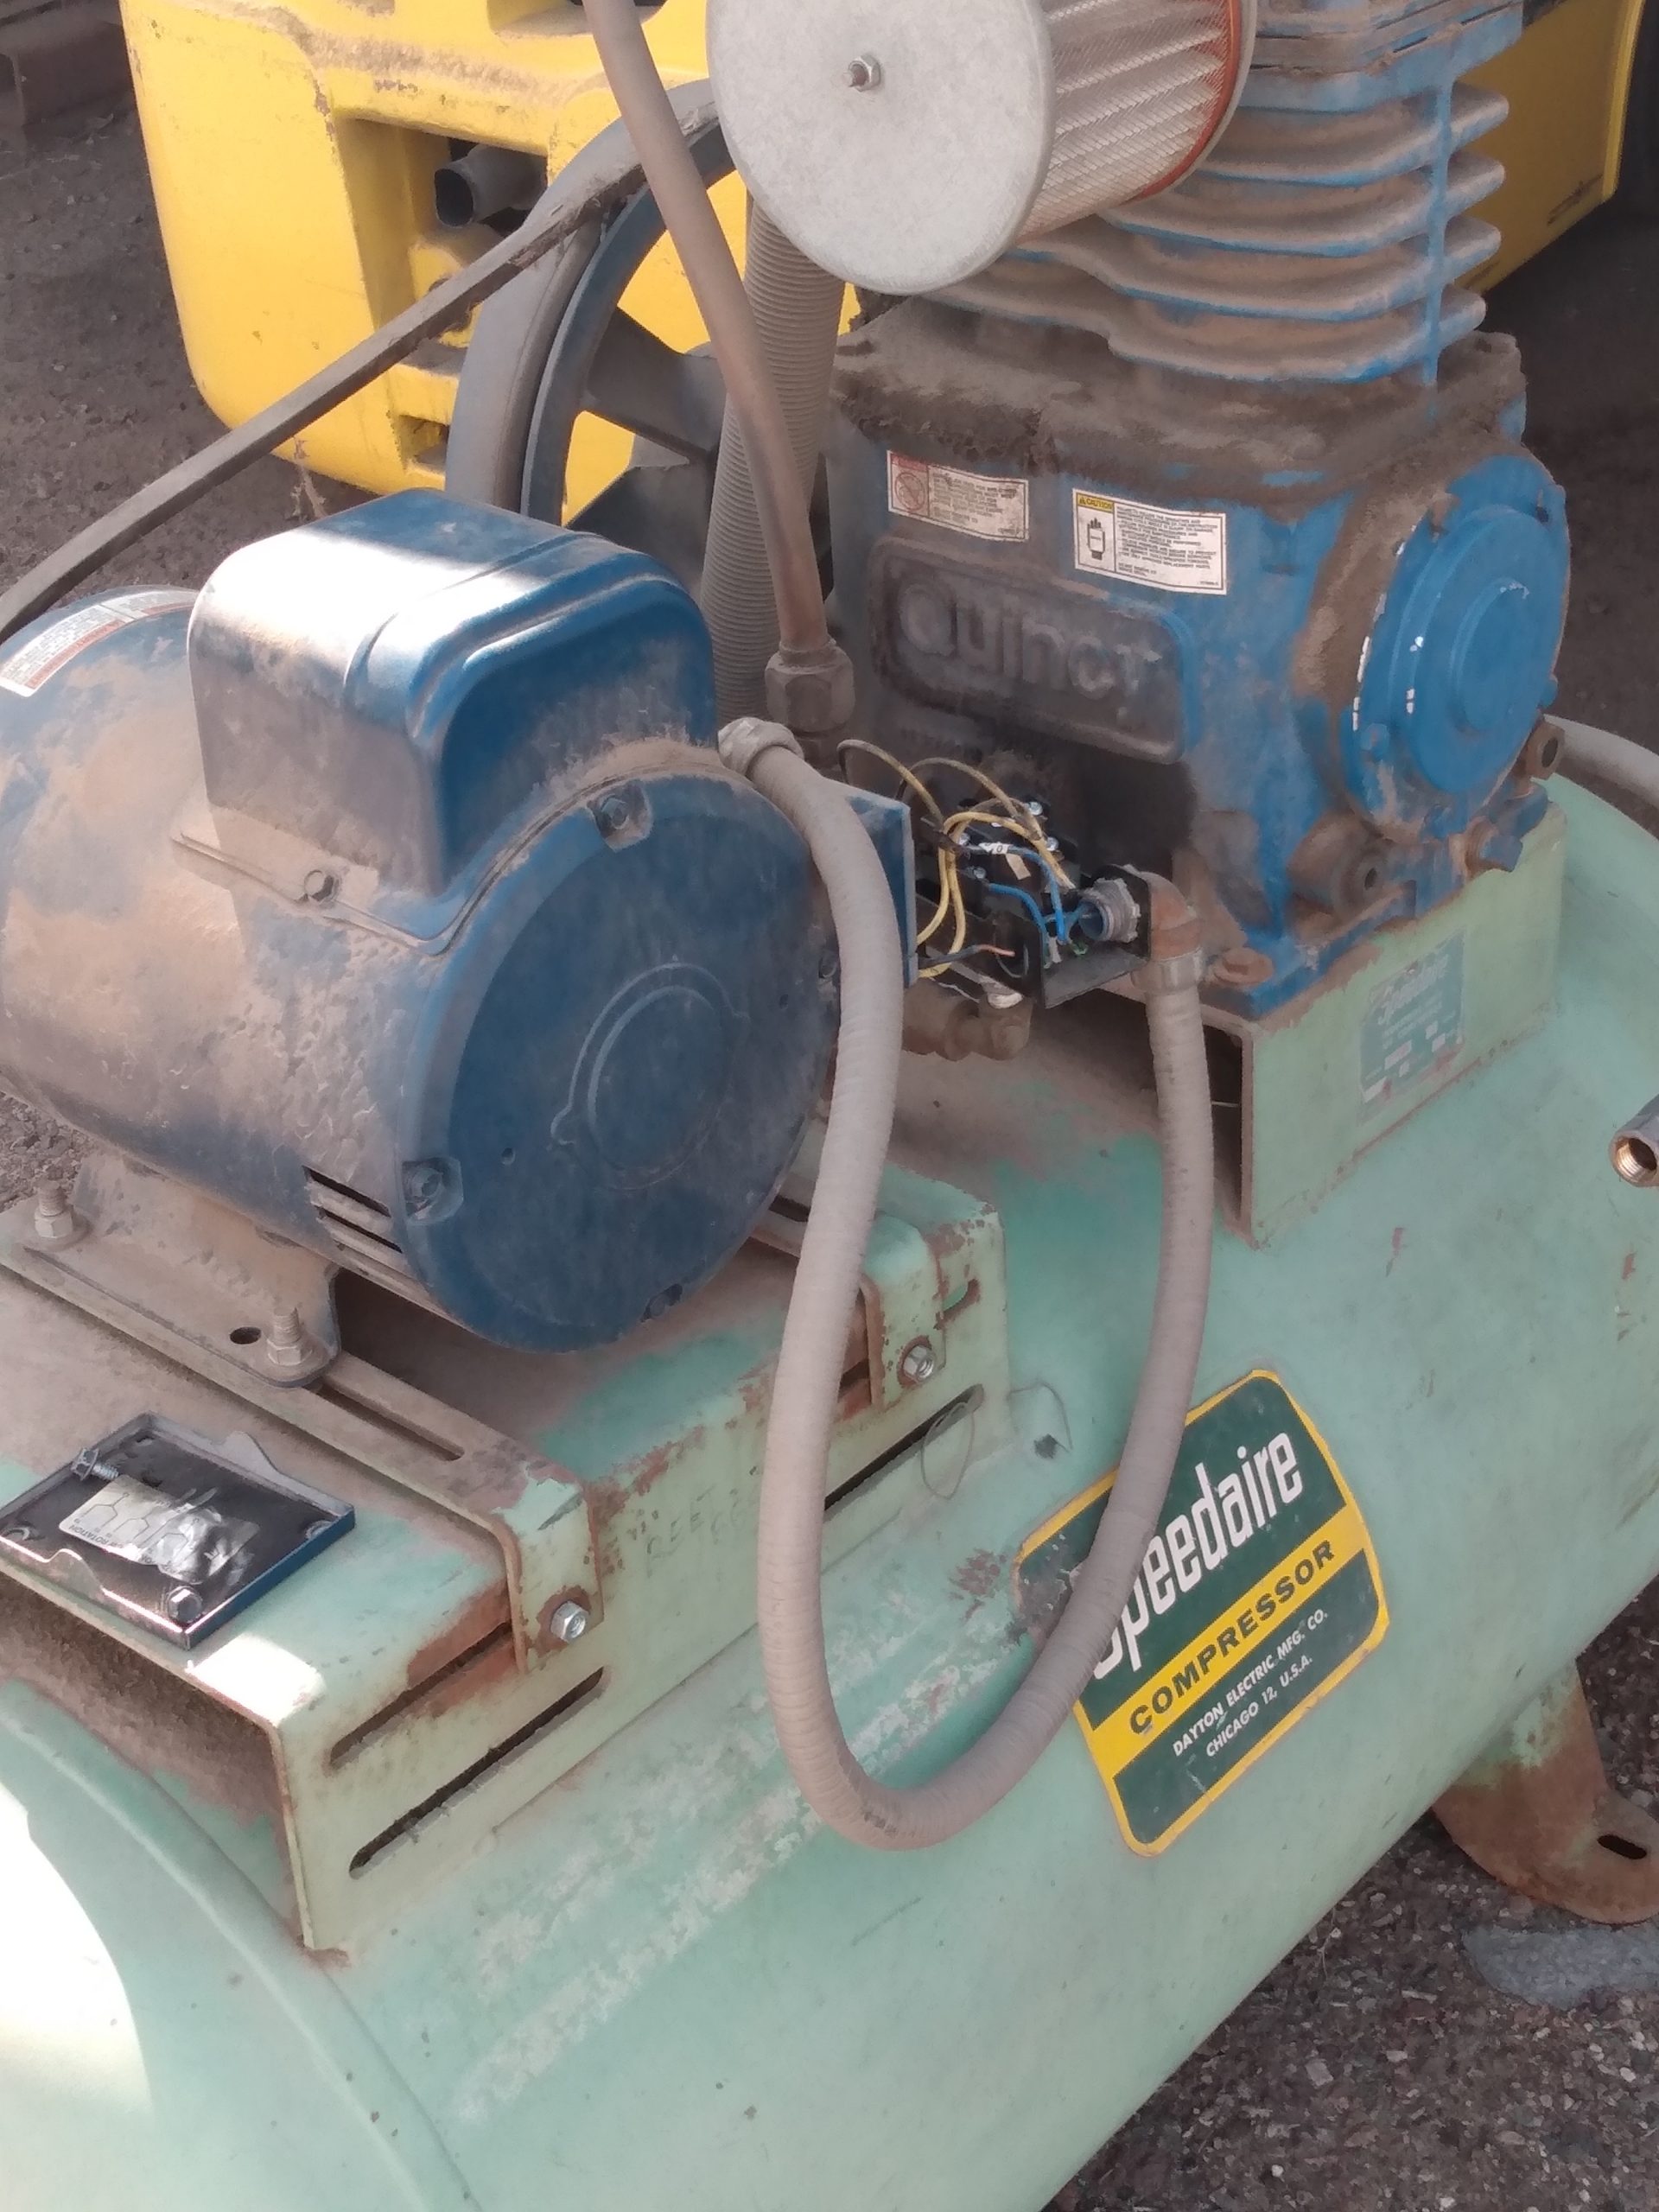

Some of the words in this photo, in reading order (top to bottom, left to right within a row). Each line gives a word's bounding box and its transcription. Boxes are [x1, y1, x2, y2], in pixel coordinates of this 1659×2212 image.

[1086, 498, 1112, 510] CAUTION
[1129, 1539, 1335, 1735] COMPRESSOR
[1173, 1702, 1224, 1757] DAYTON
[1225, 1654, 1274, 1707] ELECTRIC
[1276, 1630, 1306, 1660] MFG.
[1306, 1608, 1328, 1631] CO.
[1206, 1701, 1259, 1758] CHICAGO
[1279, 1655, 1313, 1688] U.S.A.
